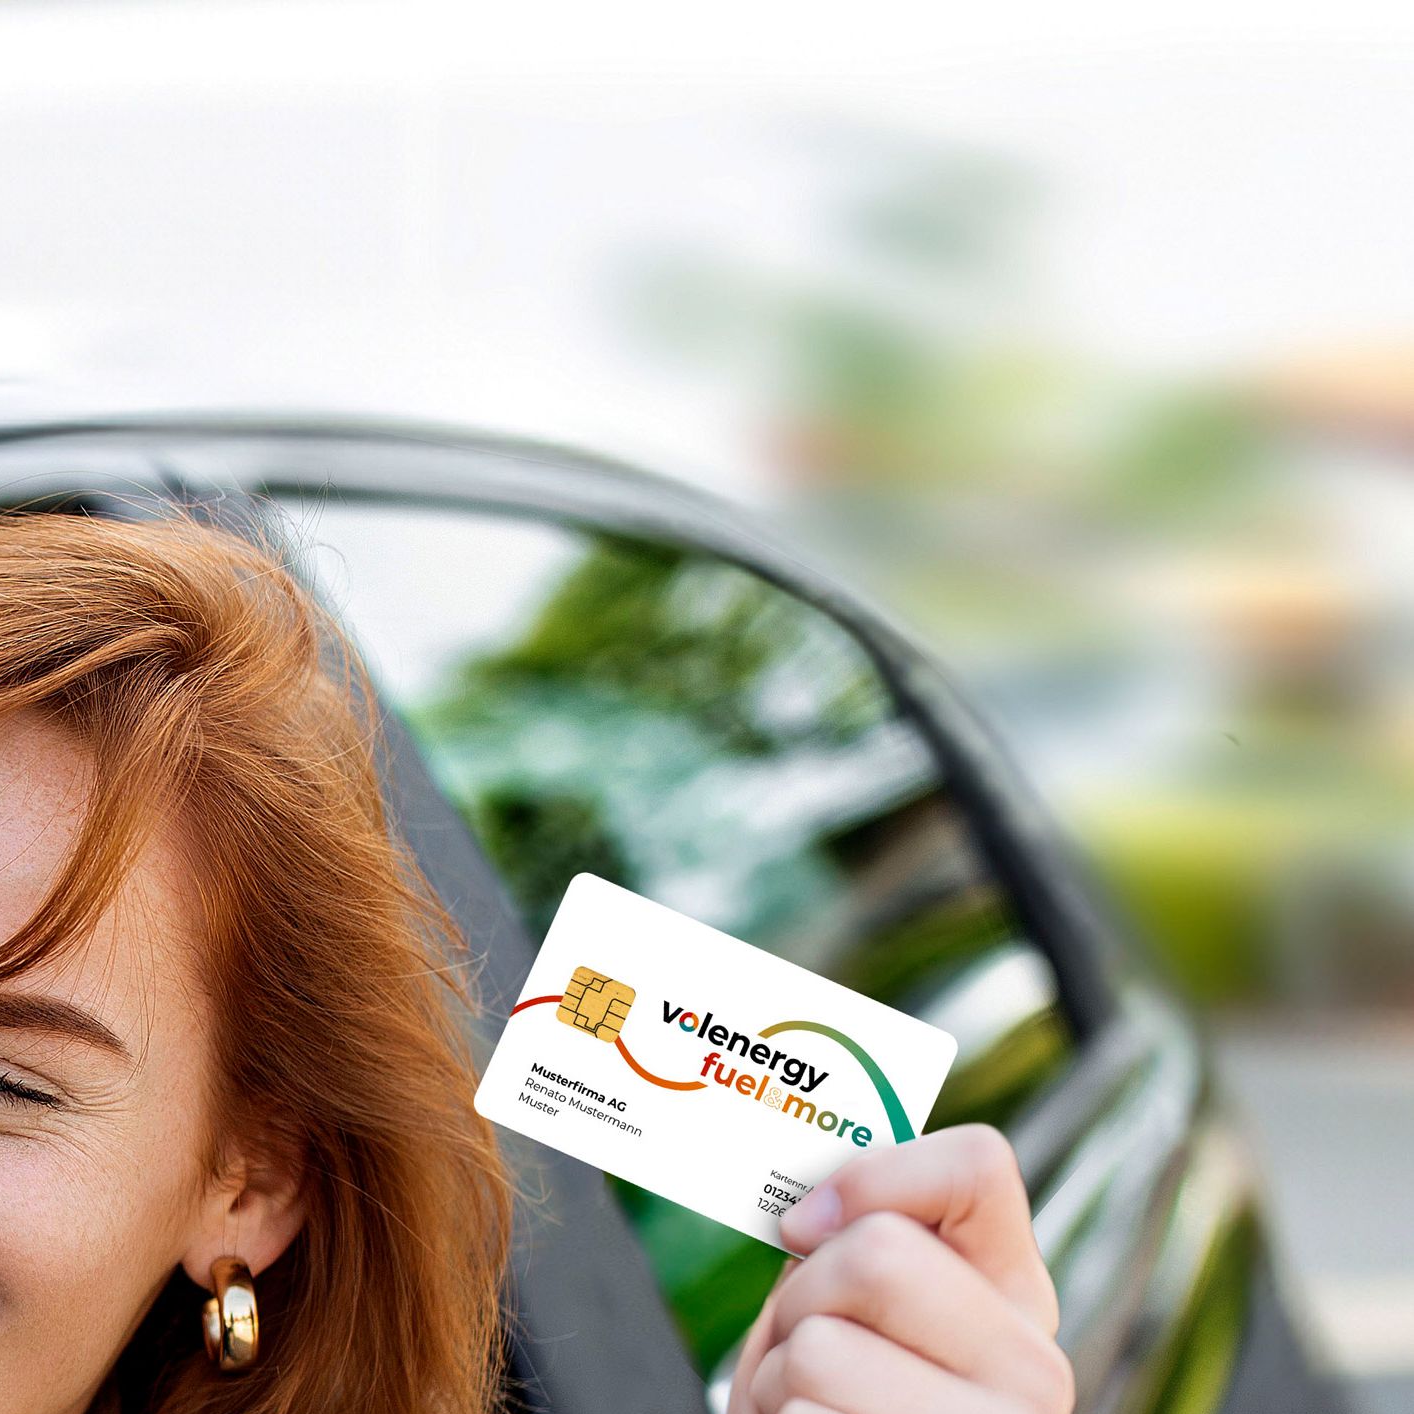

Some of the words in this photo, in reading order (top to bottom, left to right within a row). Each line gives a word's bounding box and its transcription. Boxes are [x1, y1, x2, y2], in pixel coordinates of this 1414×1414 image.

[663, 1000, 829, 1093] volenergy
[518, 1092, 560, 1117] Muster
[525, 1077, 567, 1103] Renato
[568, 1097, 643, 1137] Mustermann
[531, 1063, 605, 1103] Musterfirma
[607, 1098, 627, 1112] AG
[701, 1052, 873, 1147] fuel&more
